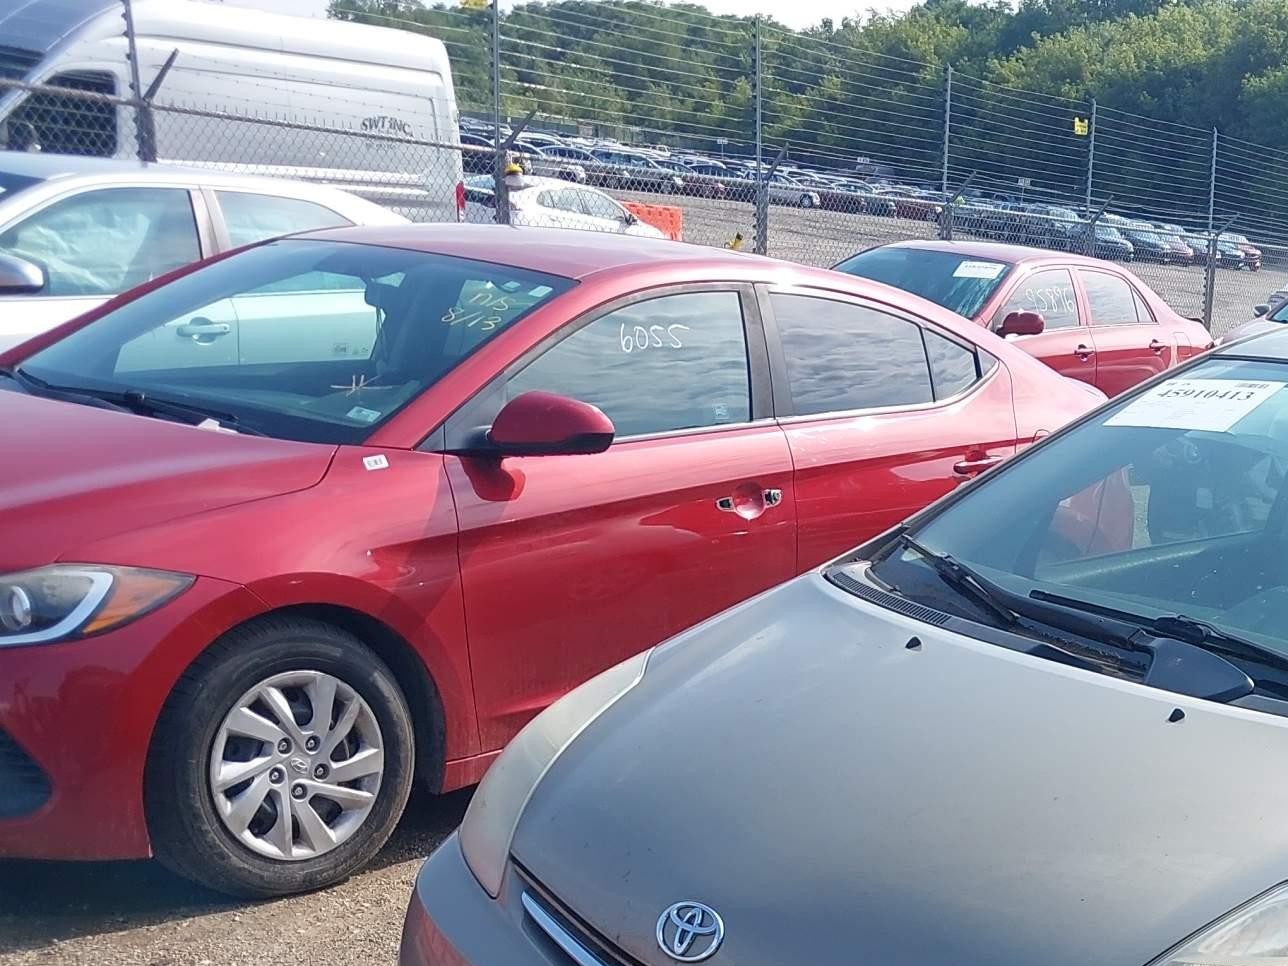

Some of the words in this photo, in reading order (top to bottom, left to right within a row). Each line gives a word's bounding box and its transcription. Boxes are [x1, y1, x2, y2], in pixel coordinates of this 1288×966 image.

[441, 306, 502, 330] 8/13
[620, 322, 690, 353] 6055
[1157, 389, 1255, 401] 45910413
